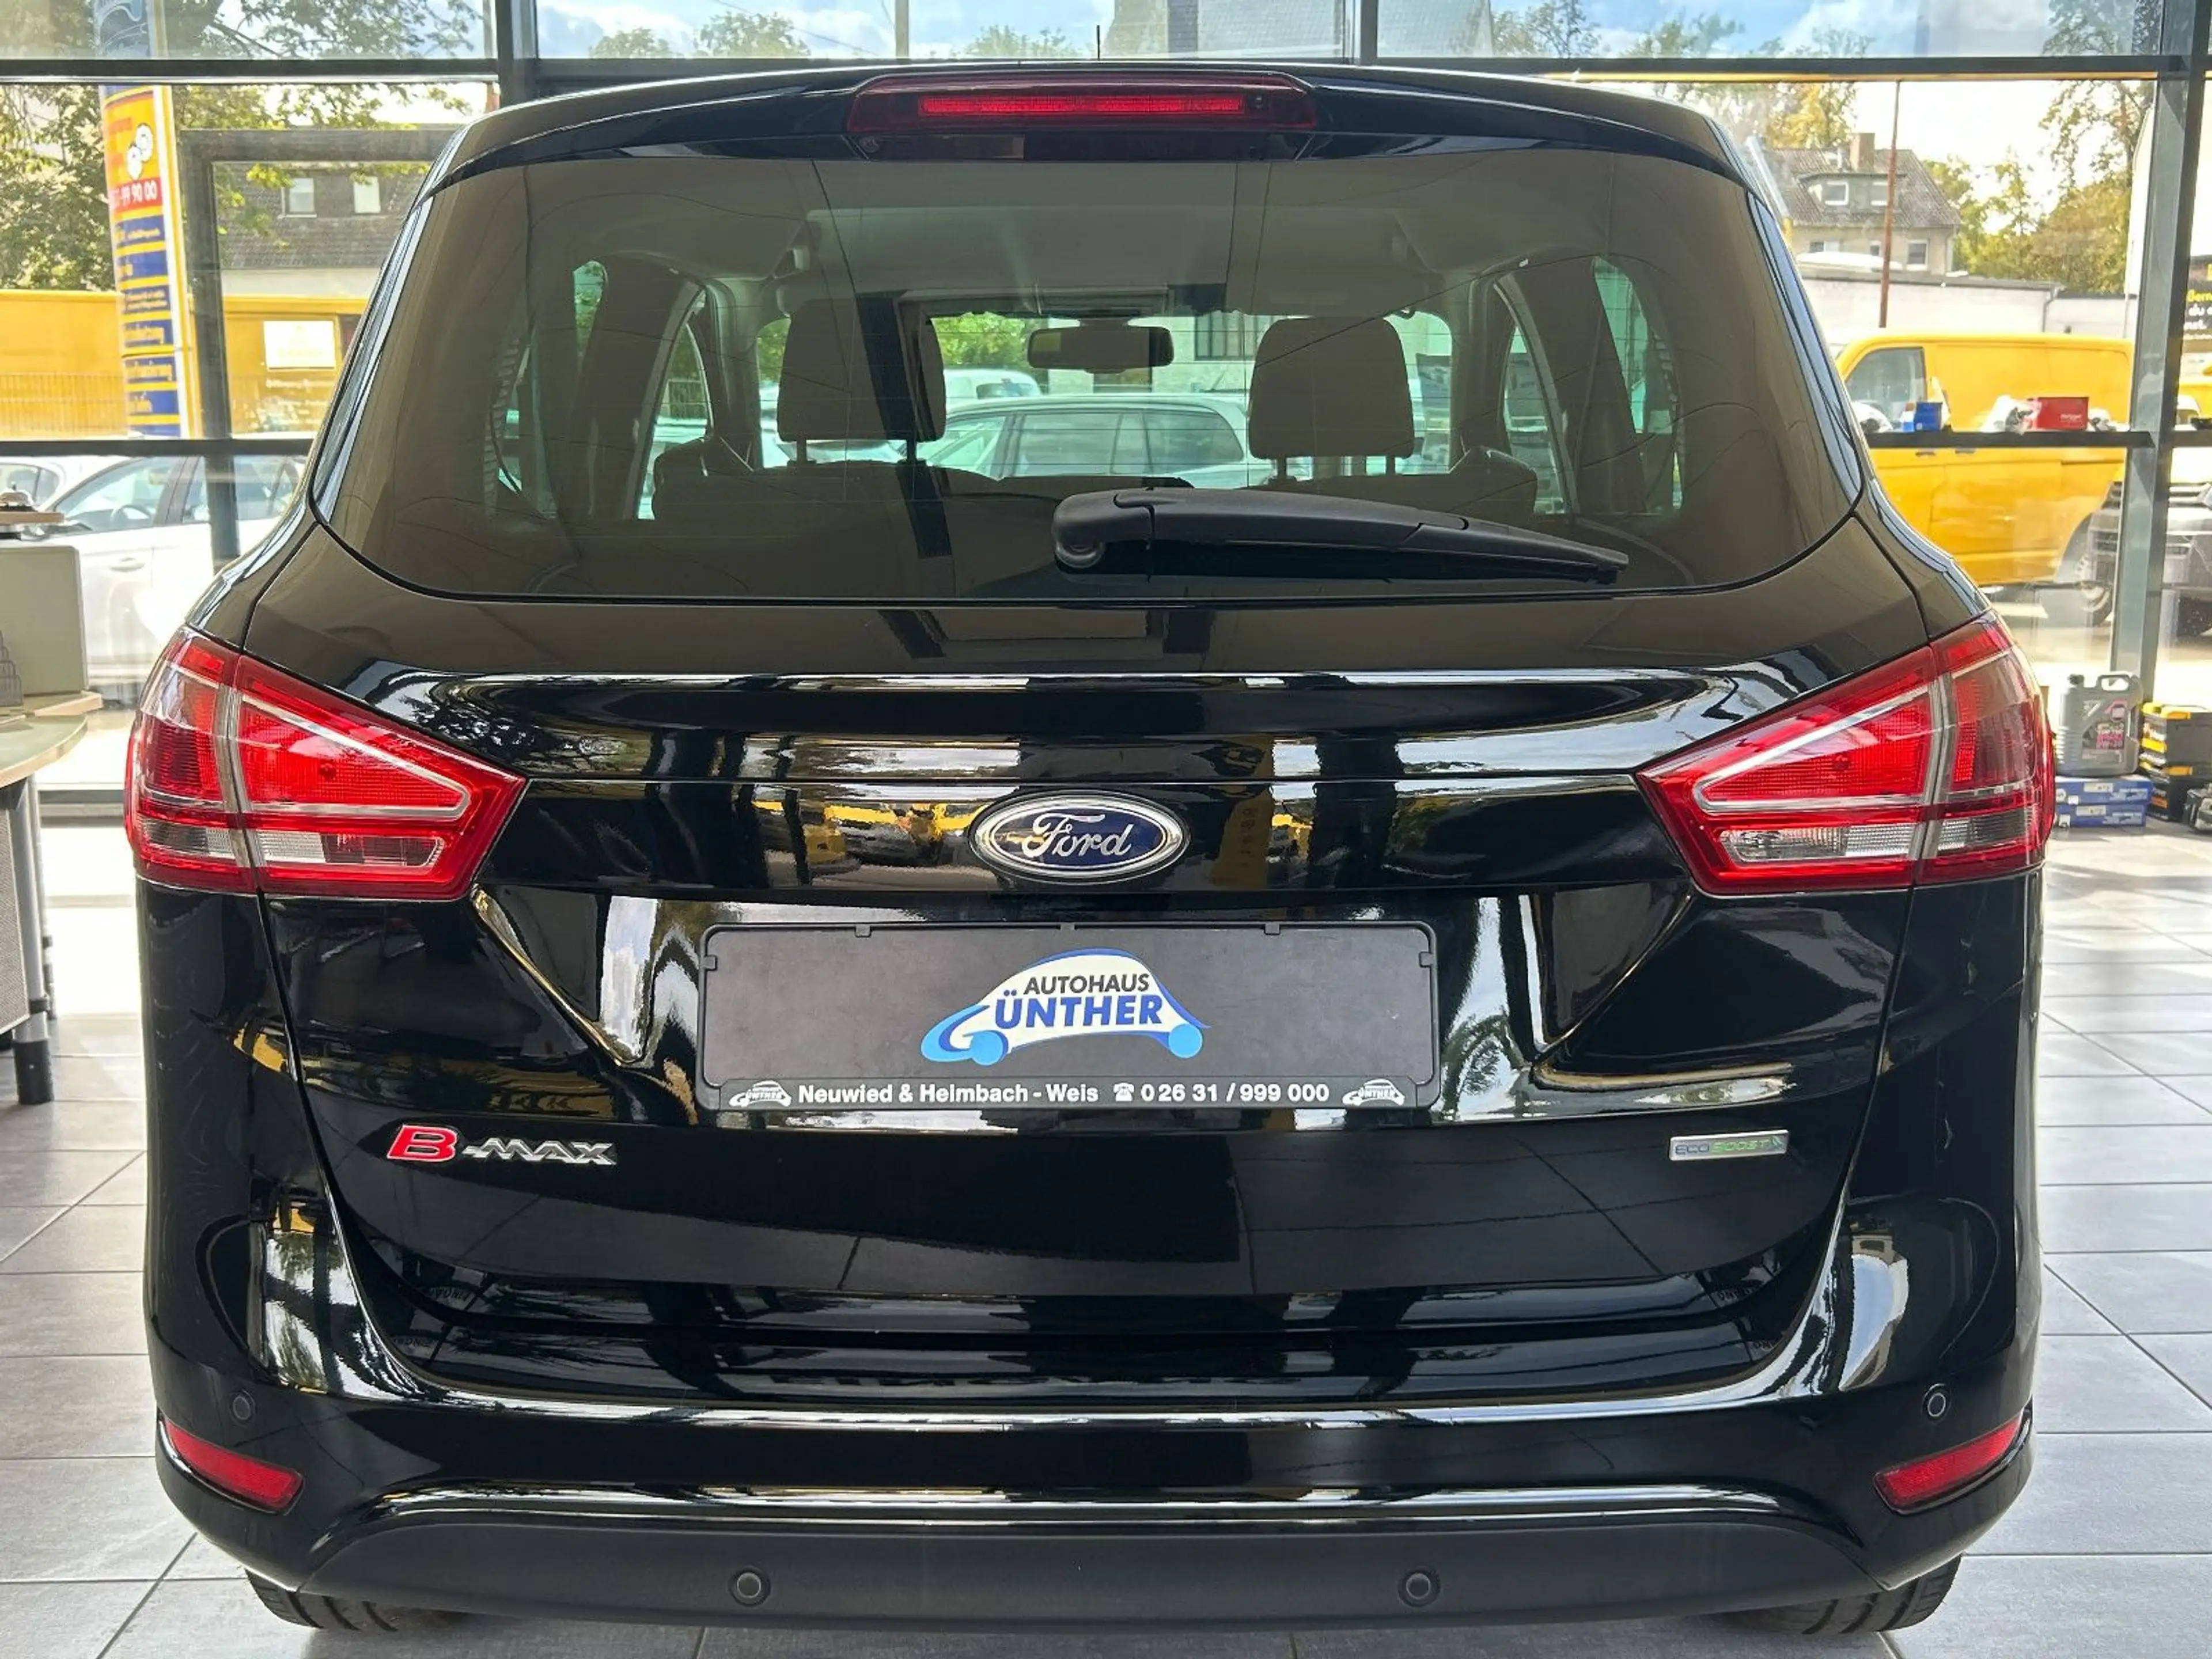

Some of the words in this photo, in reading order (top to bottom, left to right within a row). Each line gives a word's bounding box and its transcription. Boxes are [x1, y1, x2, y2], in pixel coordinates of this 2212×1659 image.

[1021, 812, 1134, 858] Ford
[1023, 973, 1150, 995] AUTOHAUS
[798, 1084, 893, 1103] Neuwied
[899, 1084, 914, 1103] &
[1044, 1084, 1099, 1103] Weis
[1287, 1084, 1330, 1102] 000
